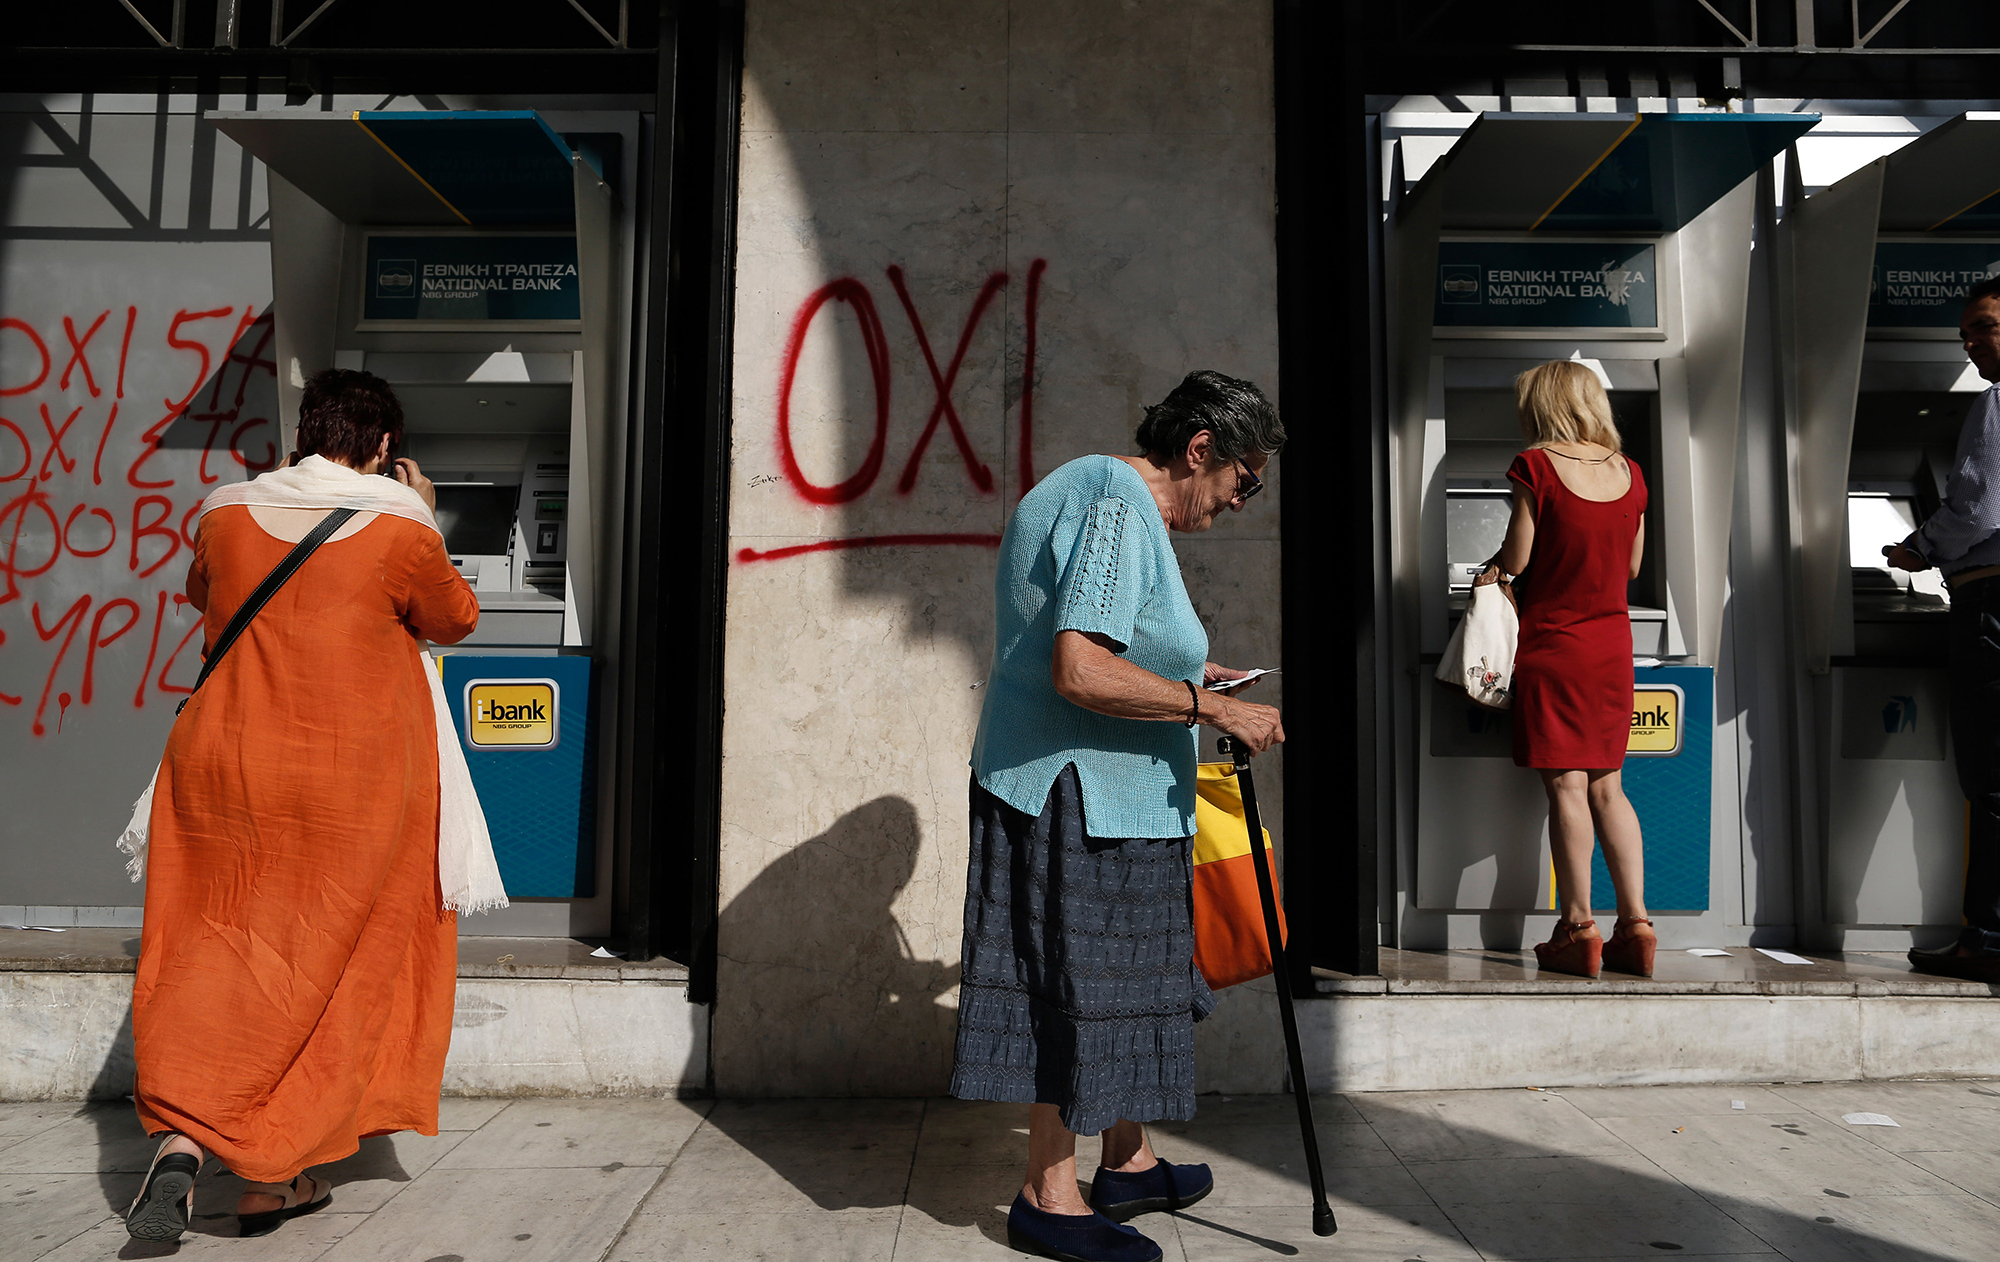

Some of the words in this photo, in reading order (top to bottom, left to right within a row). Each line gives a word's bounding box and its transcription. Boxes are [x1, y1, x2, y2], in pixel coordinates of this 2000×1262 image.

[423, 264, 490, 276] ΕΘΝΙΚΗ
[494, 264, 577, 276] ΤΡΑΠΕΖΑ
[1488, 270, 1556, 282] ΕΘΝΙΚΗ
[1560, 270, 1646, 283] ΤΡΑΠΖΑ
[1886, 270, 1955, 283] ΕΘΝΙΚΗ
[1959, 270, 2000, 283] ΤΡΑ
[422, 278, 508, 290] NATIONAL
[512, 278, 562, 290] BANK
[1488, 284, 1577, 297] NATIONAL
[422, 291, 443, 299] NBG
[444, 291, 479, 299] GROUP
[1887, 298, 1908, 306] NBG
[1910, 298, 1946, 306] GROUP
[477, 698, 546, 721] i-bank
[1631, 705, 1670, 727] ank
